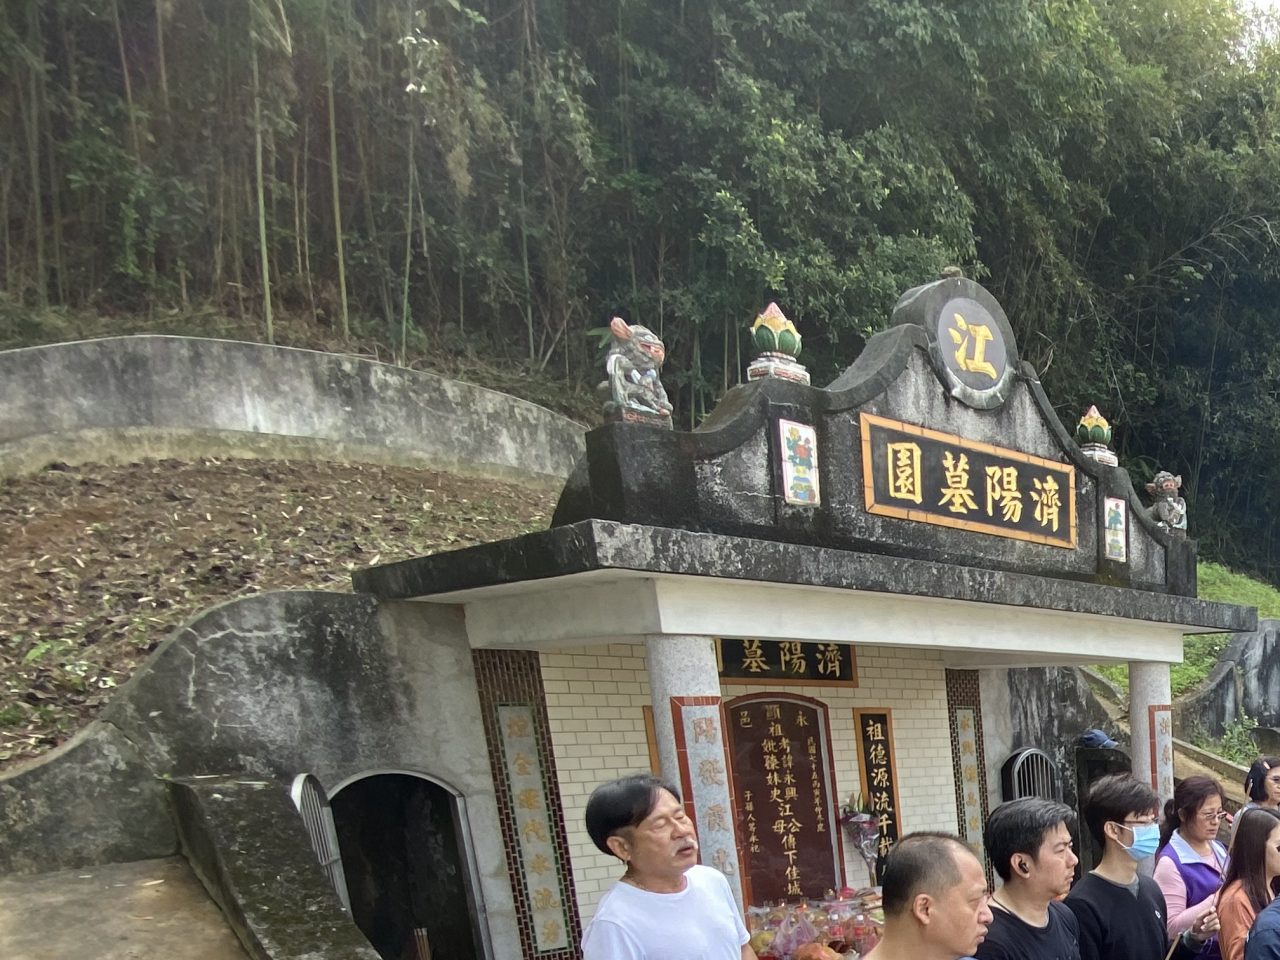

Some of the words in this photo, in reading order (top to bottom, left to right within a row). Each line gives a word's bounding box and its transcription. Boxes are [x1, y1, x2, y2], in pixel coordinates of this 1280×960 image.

[948, 312, 998, 380] 江
[886, 441, 1062, 533] 濟陽墓園
[717, 639, 844, 679] 濟陽墓
[865, 719, 895, 877] 祖德源流千載
